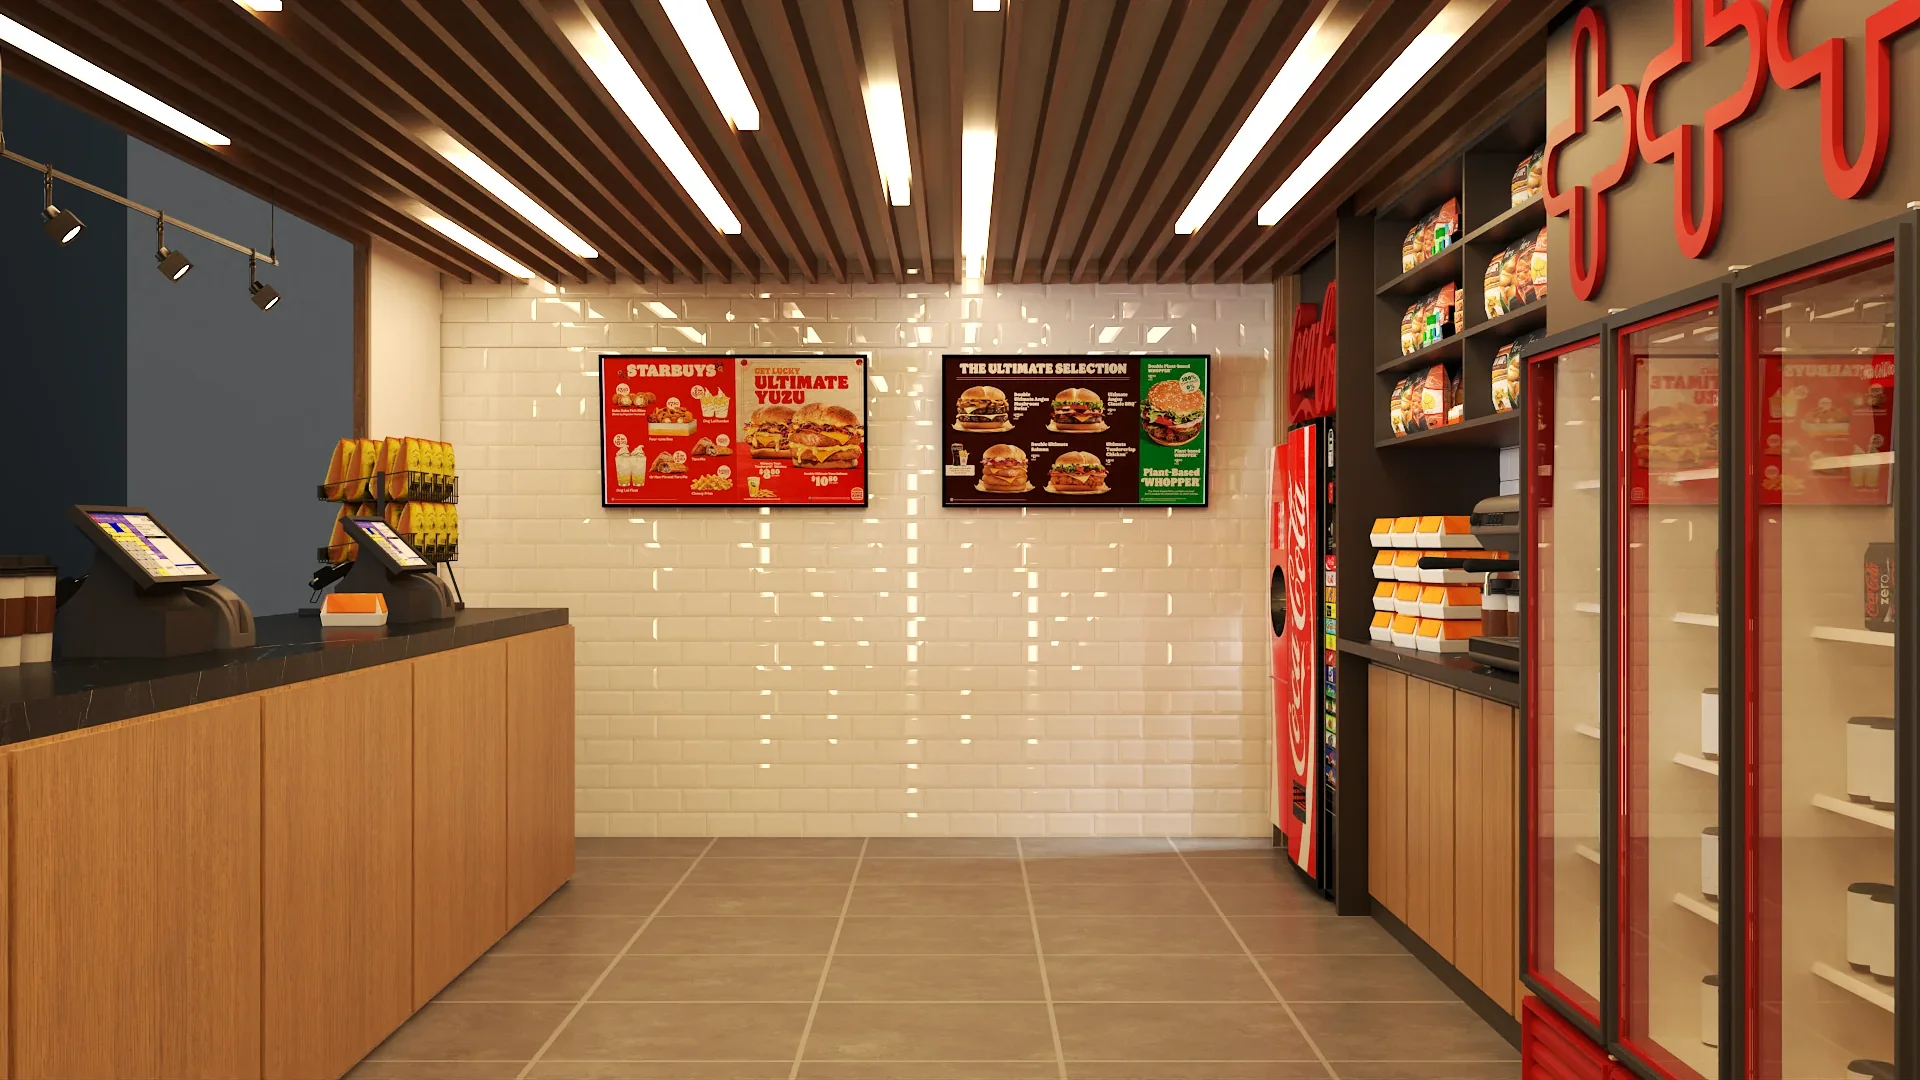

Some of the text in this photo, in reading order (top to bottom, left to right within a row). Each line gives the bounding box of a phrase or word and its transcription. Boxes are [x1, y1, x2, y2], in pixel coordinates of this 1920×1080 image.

[626, 364, 717, 377] STARBUYS
[754, 367, 801, 375] GET LUCKY
[959, 362, 1127, 375] THE ULTIMATE SELECTION
[754, 375, 849, 390] ULTIMATE
[754, 390, 805, 405] YUZU
[1143, 467, 1201, 477] Plant-Based
[1140, 477, 1200, 487] WHOPPER
[1880, 574, 1890, 606] zero
